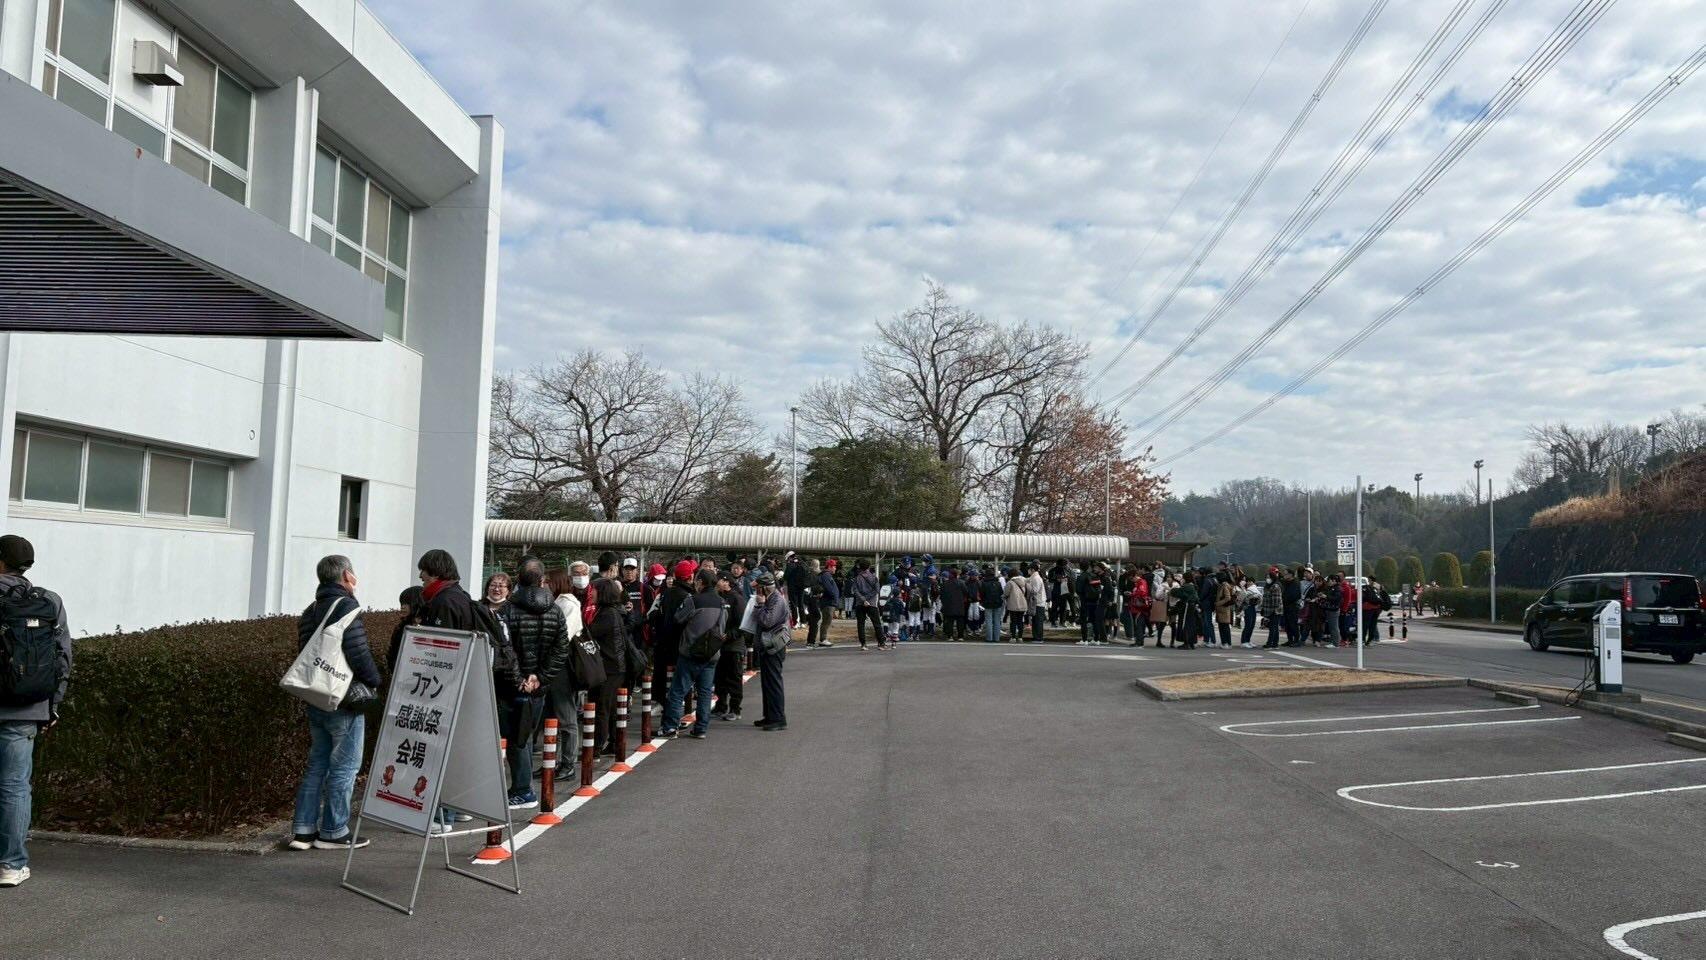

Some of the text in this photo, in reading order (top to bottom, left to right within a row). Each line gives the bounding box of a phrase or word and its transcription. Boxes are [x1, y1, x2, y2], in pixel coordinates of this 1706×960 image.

[410, 672, 444, 699] ファン
[395, 704, 443, 735] 感謝祭
[395, 738, 427, 769] 会場
